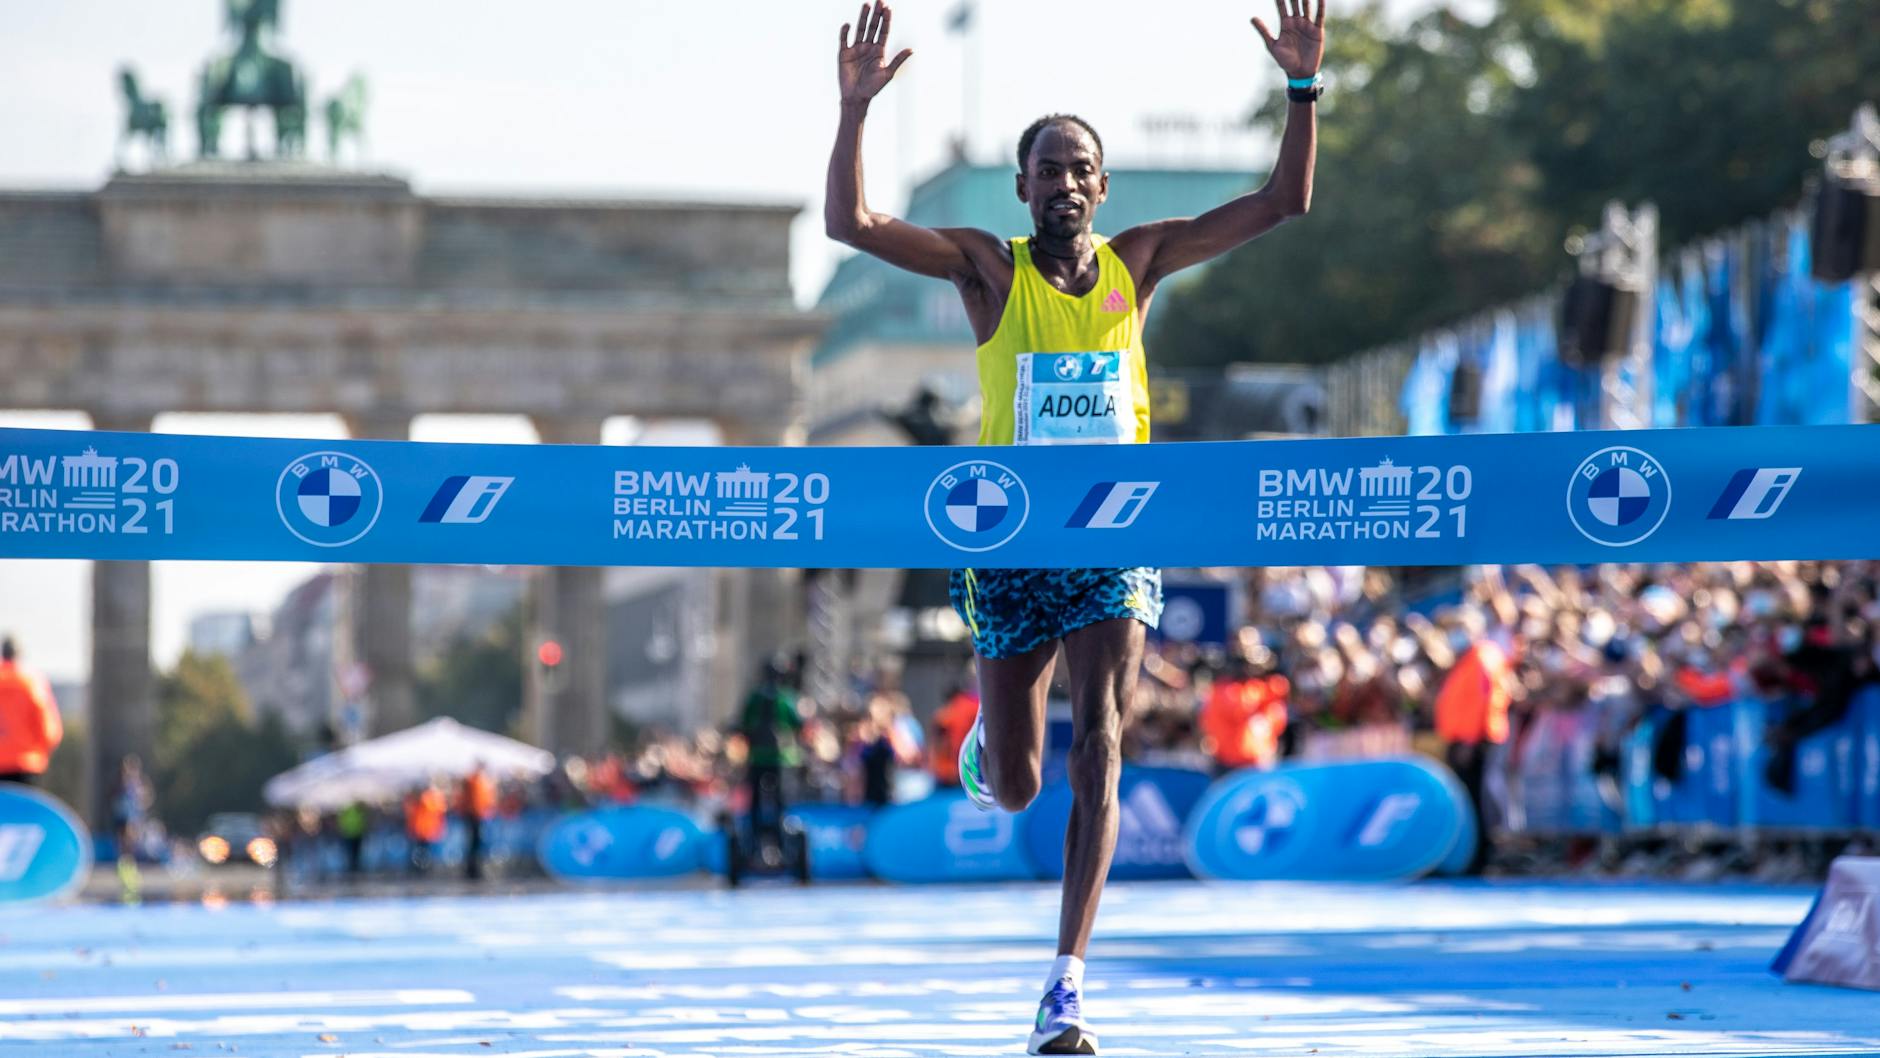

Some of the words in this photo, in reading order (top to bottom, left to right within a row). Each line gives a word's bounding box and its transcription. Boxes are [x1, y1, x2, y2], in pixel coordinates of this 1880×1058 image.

[1038, 394, 1116, 418] ADOLA
[0, 455, 57, 485] MW
[121, 457, 179, 494] 20
[291, 455, 368, 479] BMW
[940, 465, 1016, 490] BMW
[1582, 451, 1658, 480] BMW
[614, 470, 710, 497] BMW
[773, 471, 831, 504] 20
[1259, 467, 1354, 497] BMW
[1416, 465, 1472, 500] 20
[0, 488, 57, 508] RLIN
[613, 497, 711, 516] BERLIN
[1257, 499, 1353, 518] BERLIN
[0, 512, 116, 533] RATHON
[121, 498, 174, 534] 21
[613, 519, 767, 540] MARATHON
[773, 507, 824, 540] 21
[1415, 505, 1466, 538] 21
[1257, 520, 1409, 540] MARATHON
